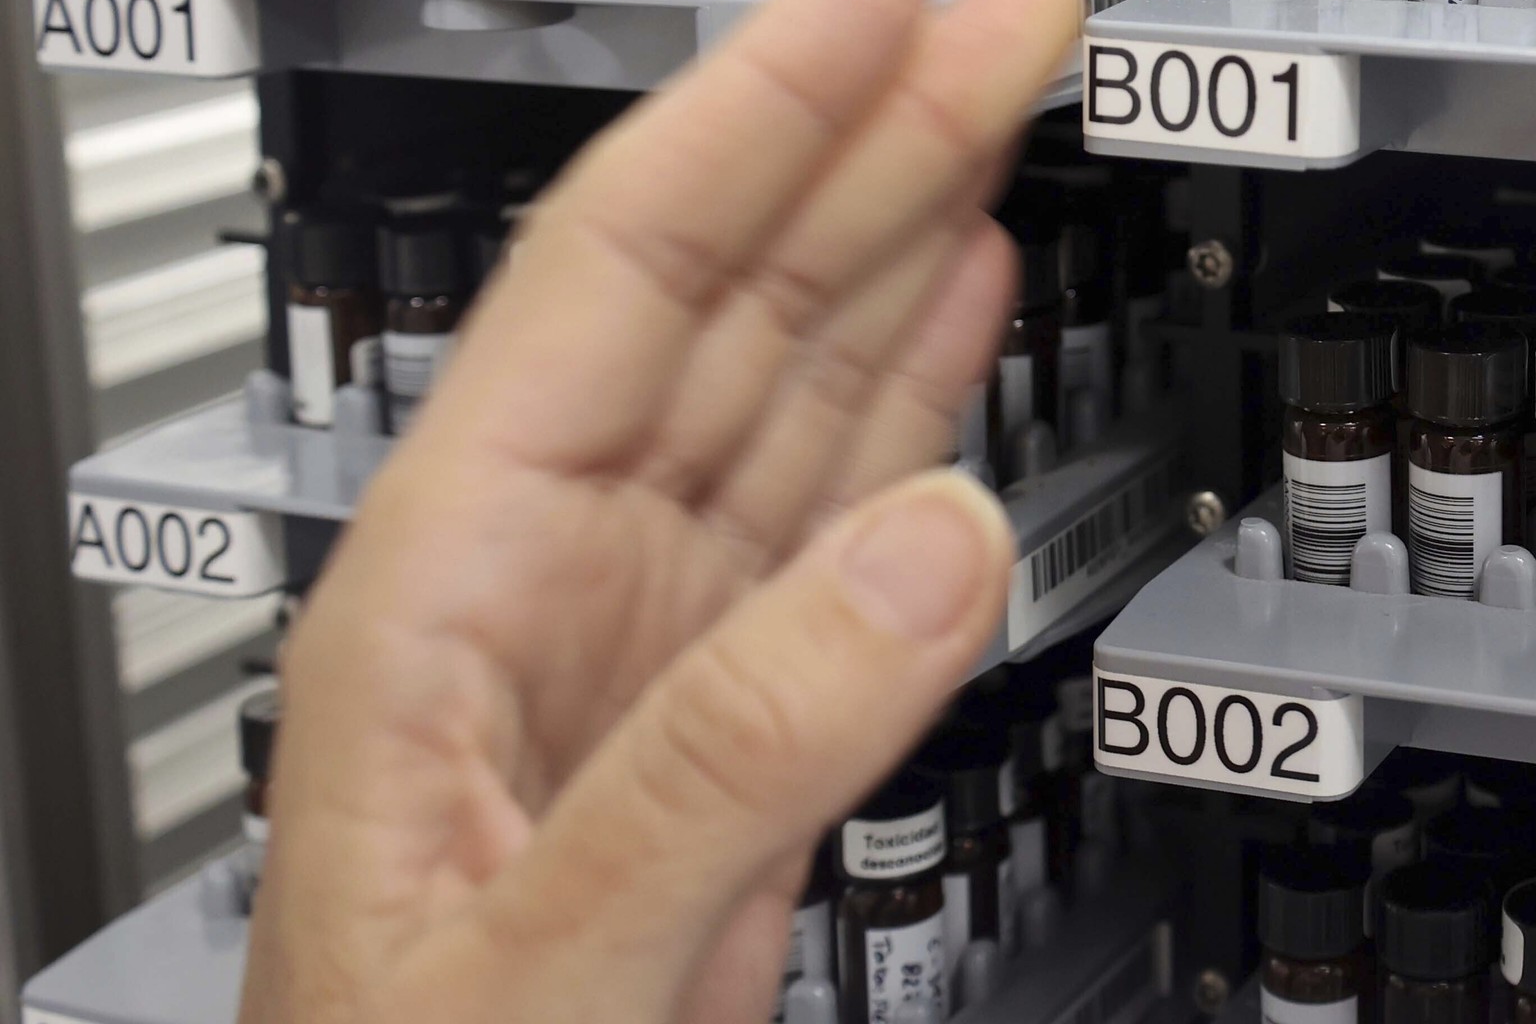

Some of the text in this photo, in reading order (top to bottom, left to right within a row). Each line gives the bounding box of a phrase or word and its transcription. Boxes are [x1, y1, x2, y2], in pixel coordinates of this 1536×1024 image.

[1089, 44, 1299, 142] B001
[71, 504, 236, 583] A002
[1097, 676, 1320, 783] B002
